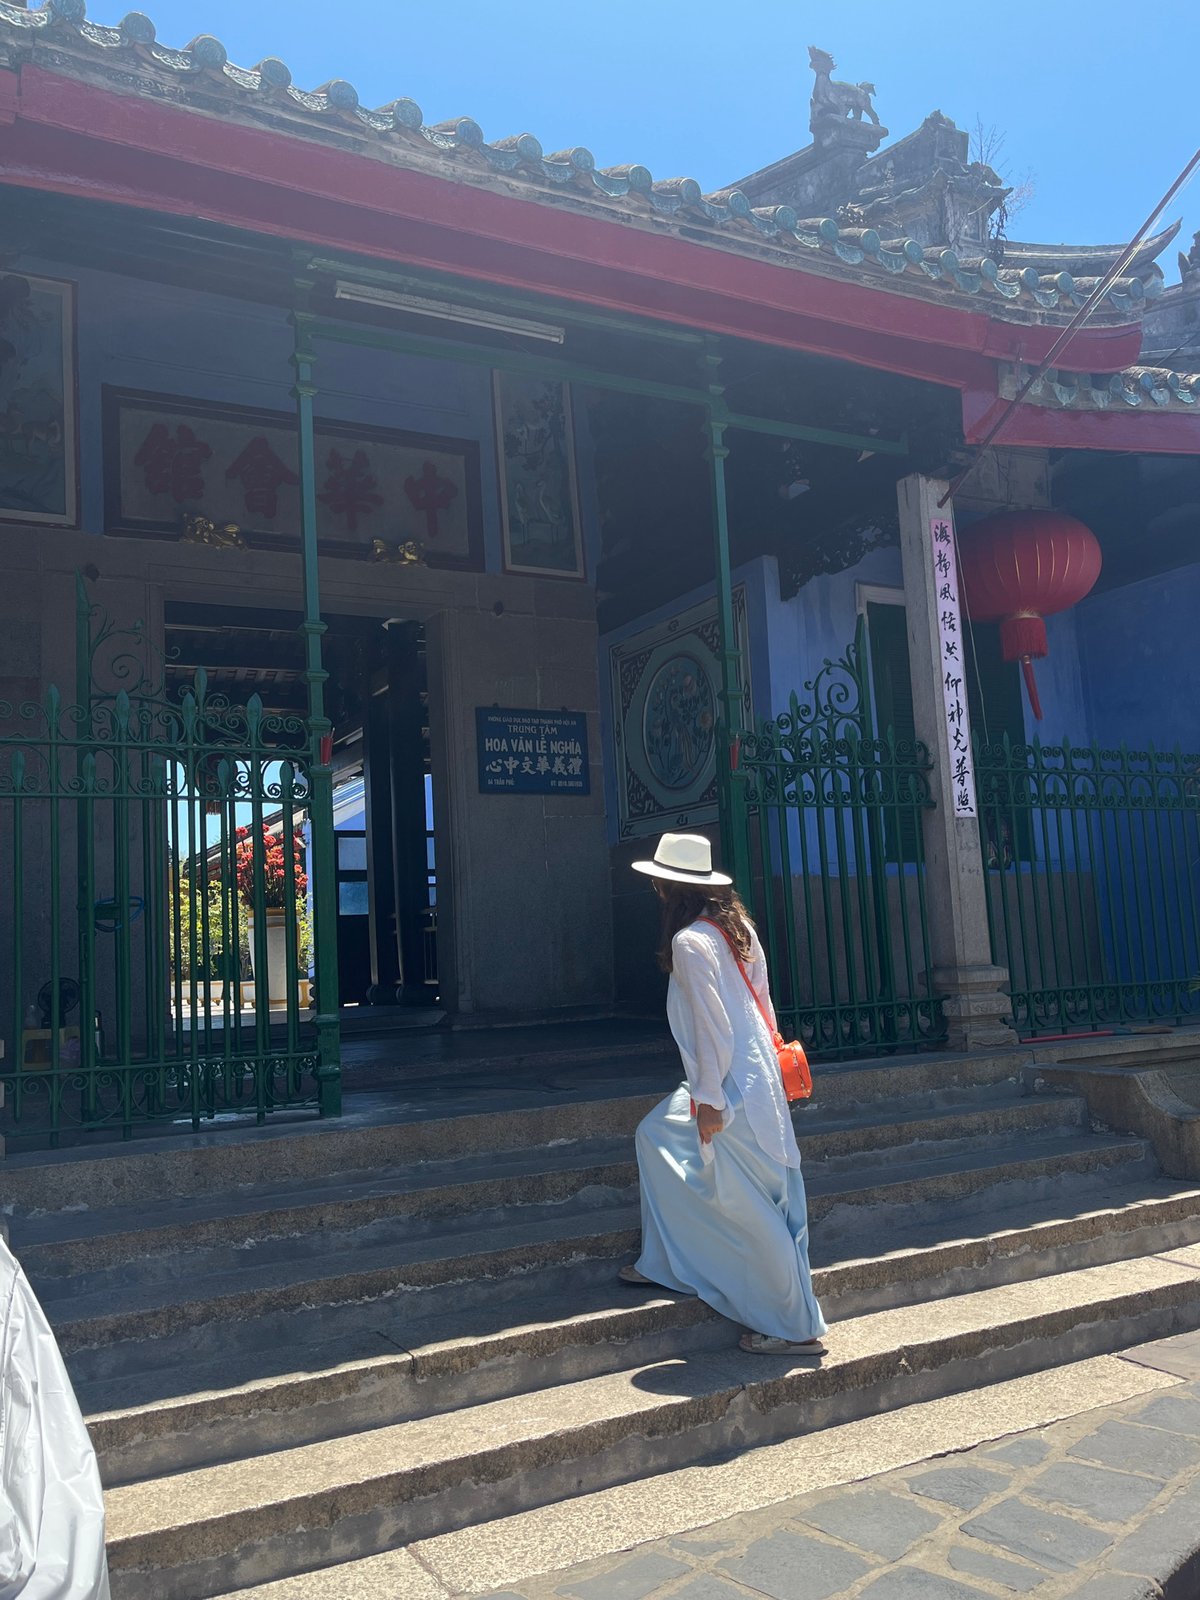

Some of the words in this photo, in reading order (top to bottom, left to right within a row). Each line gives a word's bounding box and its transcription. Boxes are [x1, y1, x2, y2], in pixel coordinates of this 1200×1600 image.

[507, 724, 537, 734] TRUNG
[539, 724, 558, 735] TÂM
[485, 738, 508, 752] HOA
[511, 736, 533, 753] VĂN
[550, 738, 582, 755] NGHĨA
